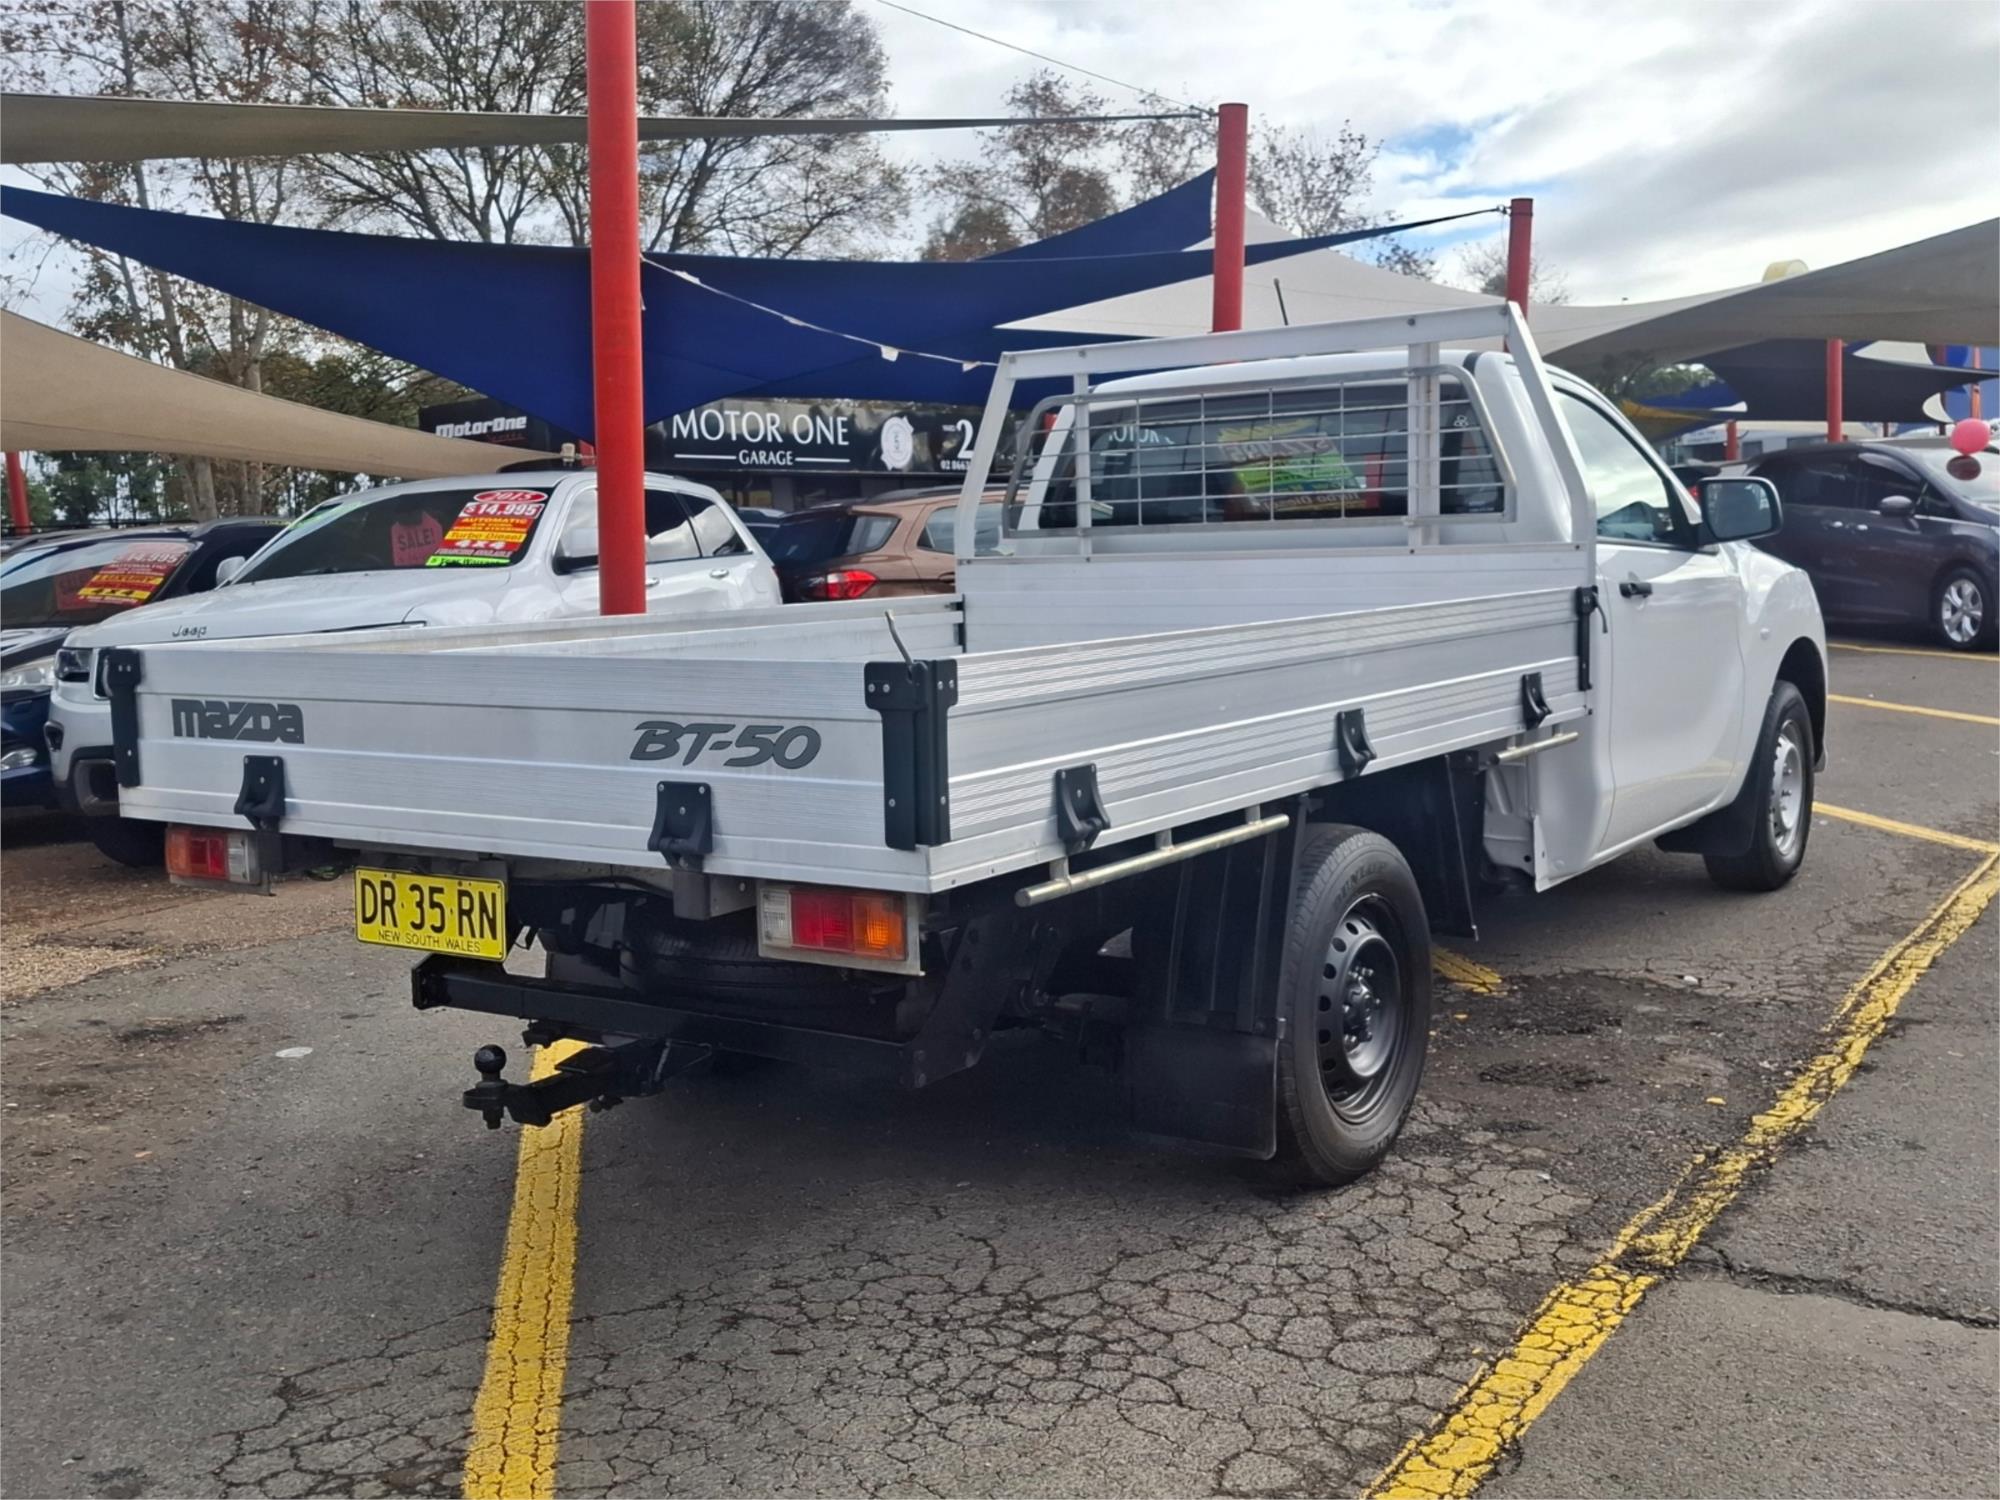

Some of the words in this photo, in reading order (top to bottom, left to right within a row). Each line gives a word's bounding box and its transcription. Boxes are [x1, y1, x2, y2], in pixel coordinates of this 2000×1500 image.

[672, 409, 783, 443] MOTOR
[793, 414, 849, 445] ONE
[738, 450, 793, 465] GARAGE
[172, 624, 207, 639] Jeep
[630, 720, 822, 770] BT-50
[360, 877, 398, 928] DR
[409, 883, 446, 934] 35
[457, 889, 497, 940] RN
[378, 929, 400, 942] NEW
[405, 932, 440, 948] SOUTH
[445, 938, 481, 953] WALES
